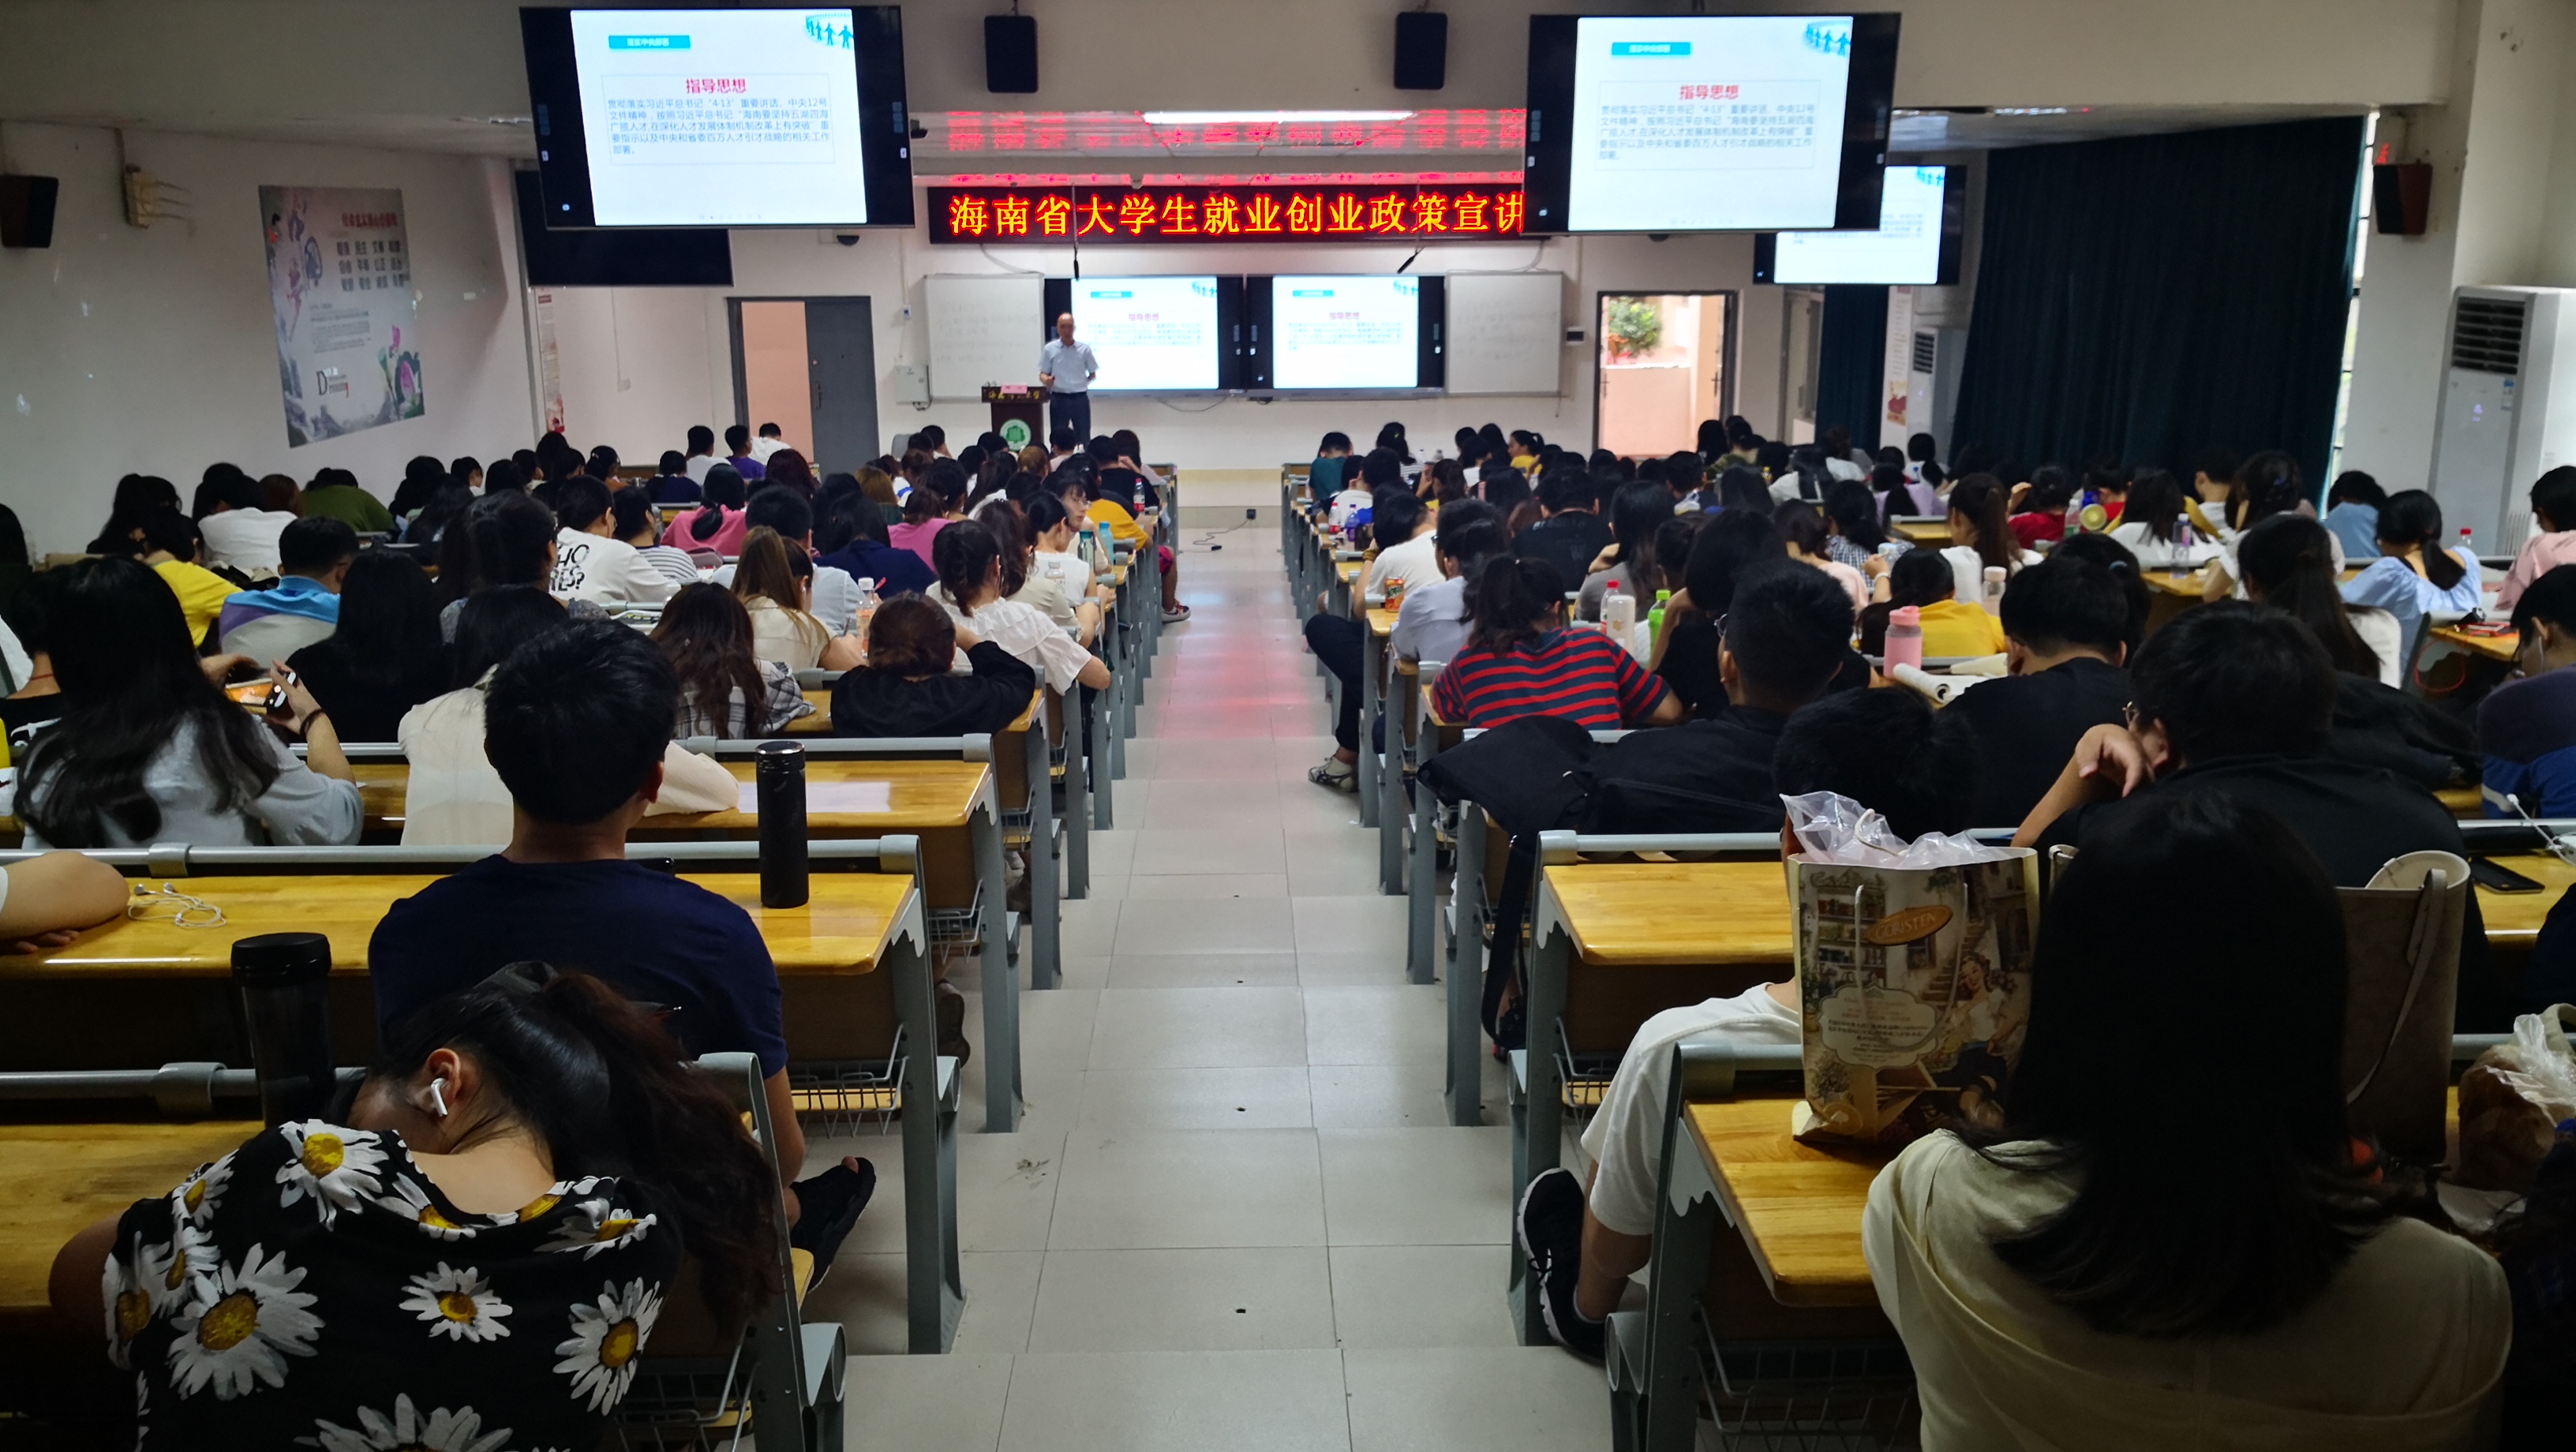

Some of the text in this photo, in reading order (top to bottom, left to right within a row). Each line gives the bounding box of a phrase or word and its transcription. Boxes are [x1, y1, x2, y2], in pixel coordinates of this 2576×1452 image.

[686, 78, 747, 94] 指导思想
[1679, 84, 1739, 99] 指导思想
[949, 193, 1524, 236] 海南省大学生就业创业政策宣讲
[557, 544, 590, 567] HO
